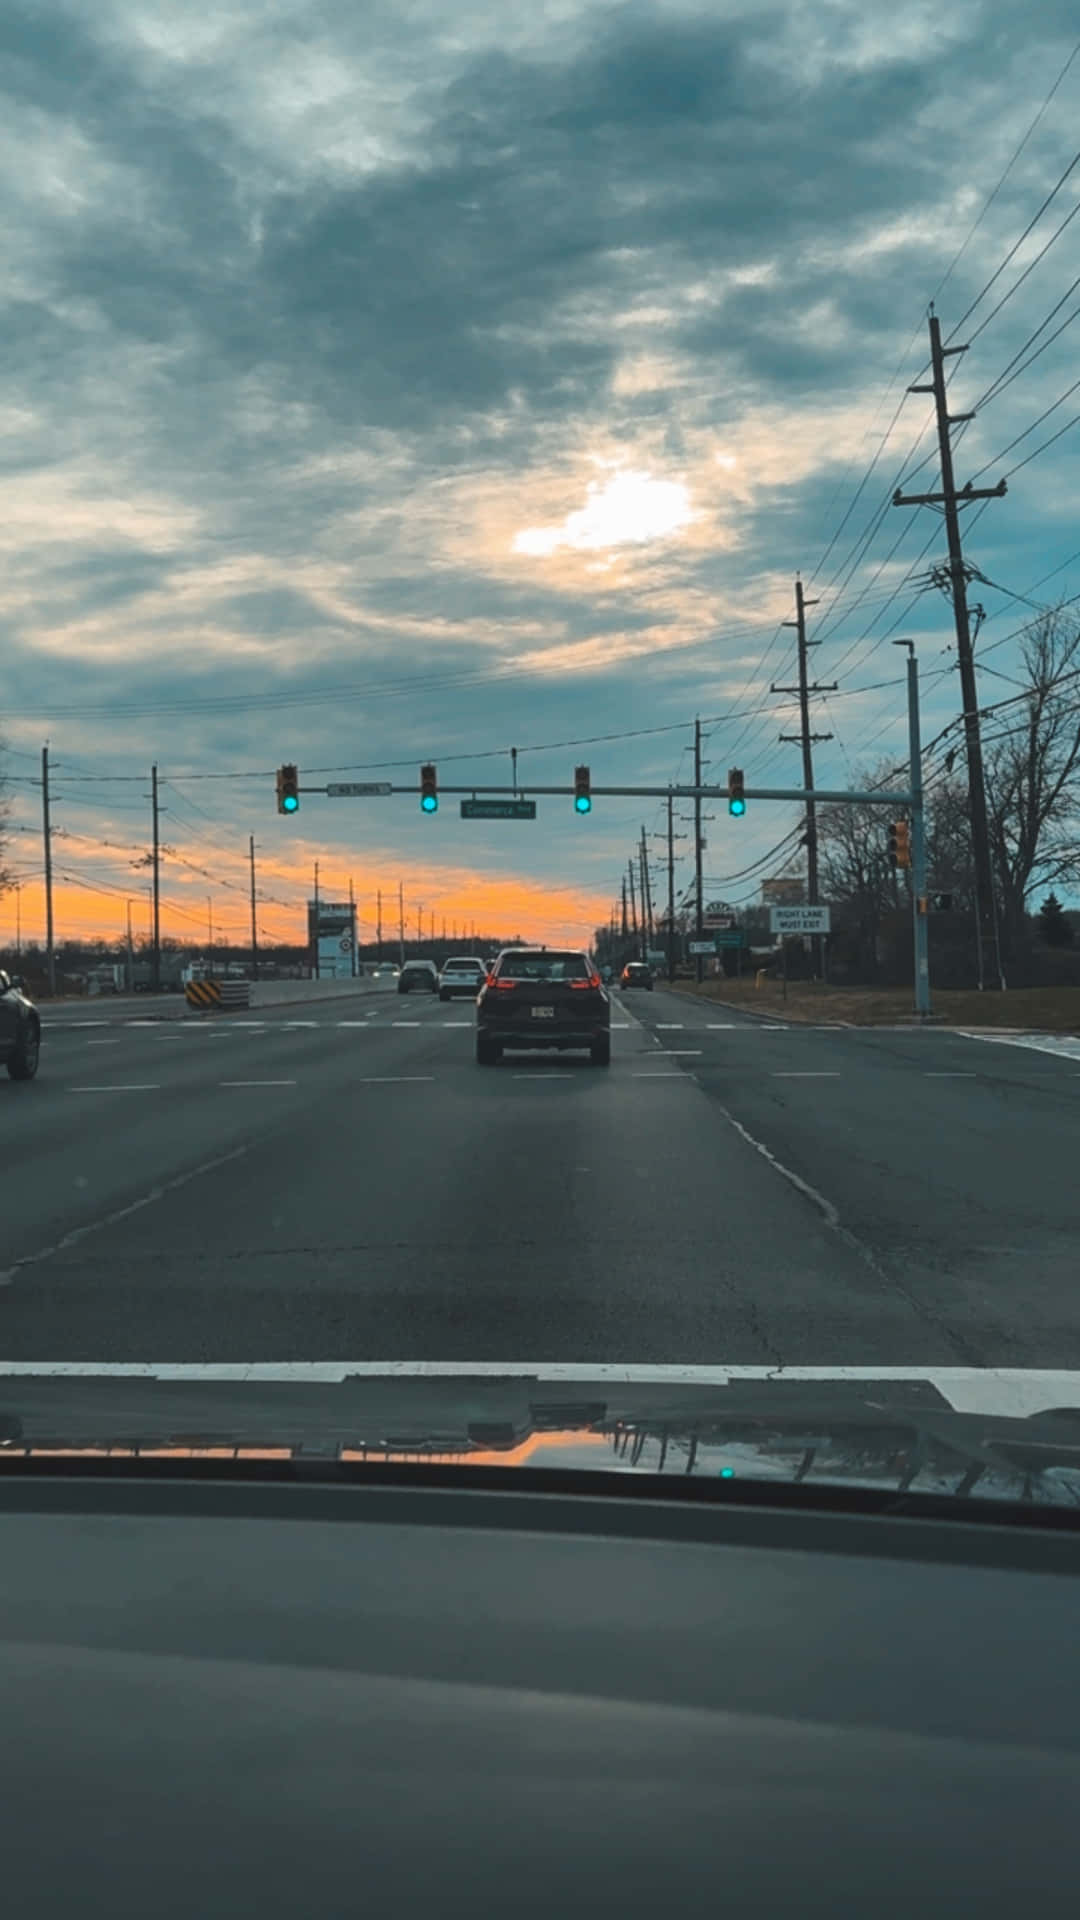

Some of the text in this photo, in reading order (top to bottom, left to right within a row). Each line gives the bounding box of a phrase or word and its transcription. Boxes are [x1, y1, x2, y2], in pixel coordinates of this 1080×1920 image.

[465, 804, 513, 816] Commerce
[776, 910, 823, 919] RIGHT LANE
[780, 919, 820, 929] MUST EXIT
